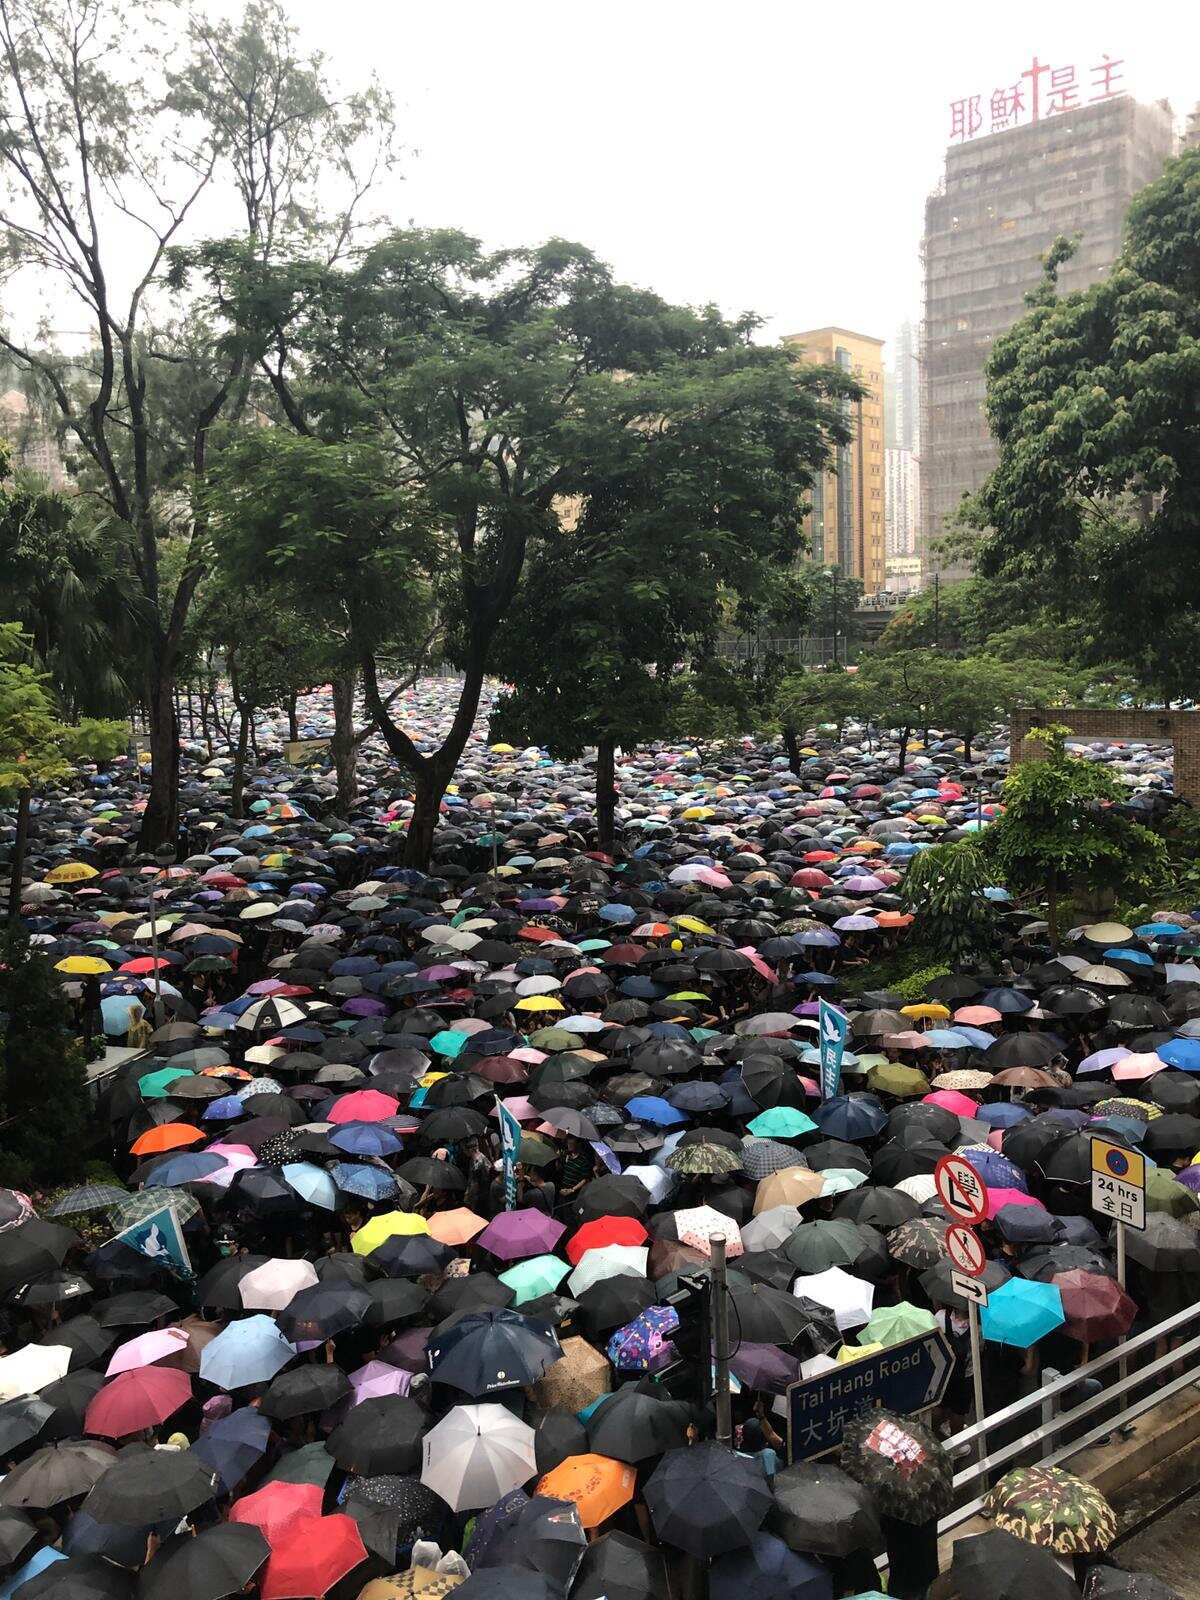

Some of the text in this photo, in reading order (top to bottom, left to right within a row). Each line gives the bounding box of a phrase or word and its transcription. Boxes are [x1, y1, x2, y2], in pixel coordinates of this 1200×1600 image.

[1098, 1177, 1137, 1202] 24 hrs
[1102, 1195, 1133, 1220] 全日
[799, 1348, 921, 1410] Tai Hang Road
[801, 1394, 875, 1446] 大坑道
